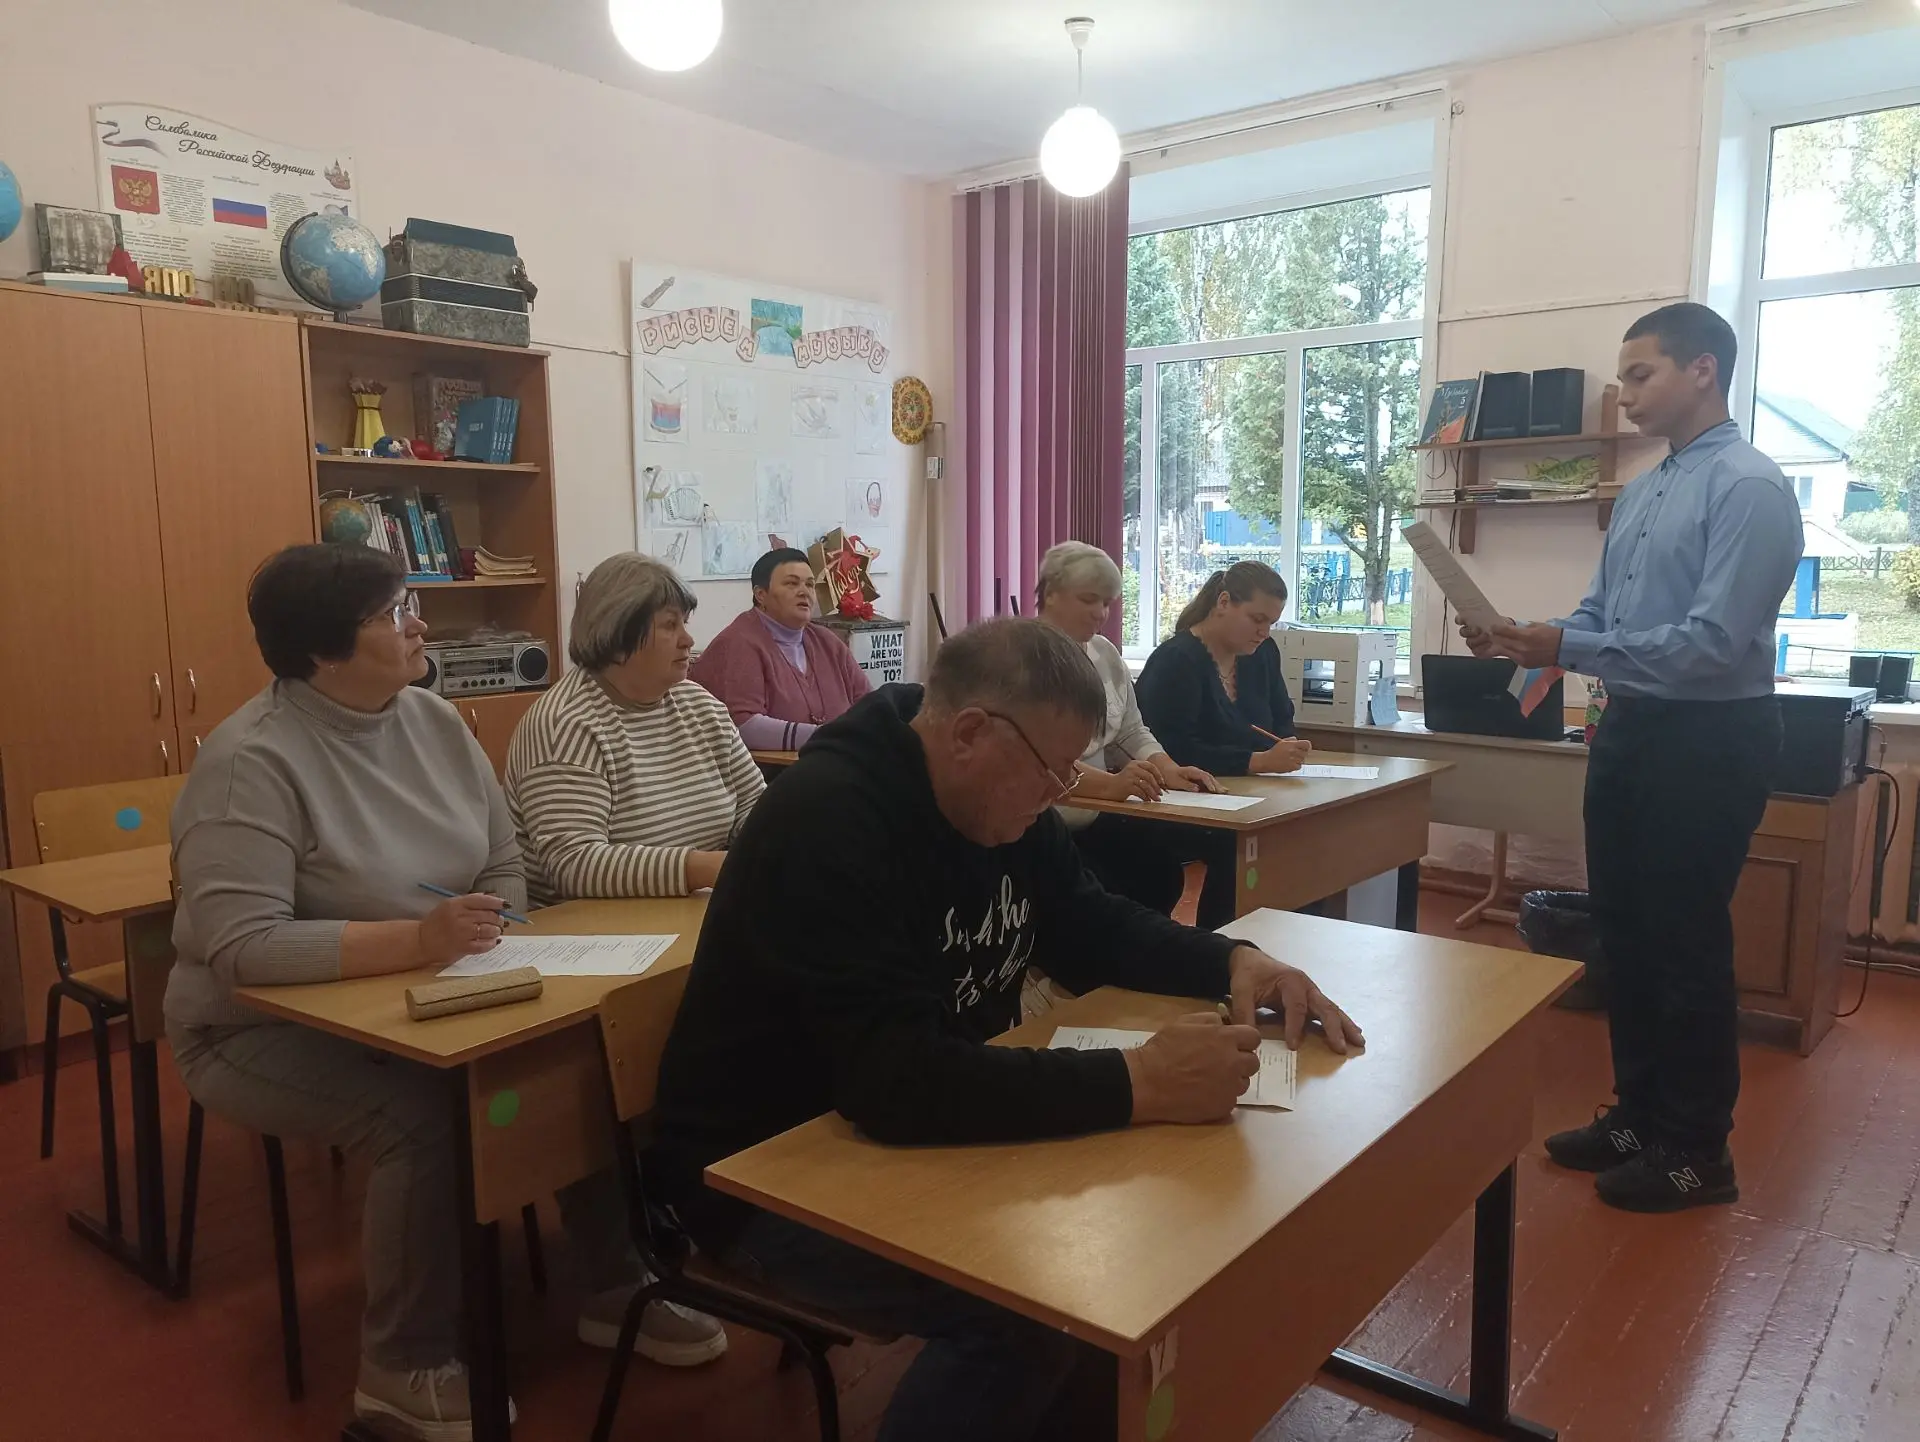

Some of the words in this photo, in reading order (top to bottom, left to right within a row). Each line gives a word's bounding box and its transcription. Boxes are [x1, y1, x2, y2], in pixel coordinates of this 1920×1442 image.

[145, 115, 217, 141] Символика
[178, 139, 249, 164] Российской
[252, 151, 316, 177] Федерации
[642, 313, 755, 357] РИСУЕМ
[797, 332, 886, 367] МУЗЫКУ
[870, 633, 903, 649] WHAT
[869, 658, 902, 670] LISTENING
[870, 649, 887, 660] ARE
[887, 648, 902, 658] YOU
[883, 668, 902, 682] TO?
[1609, 1129, 1641, 1152] N
[1668, 1167, 1701, 1192] N
